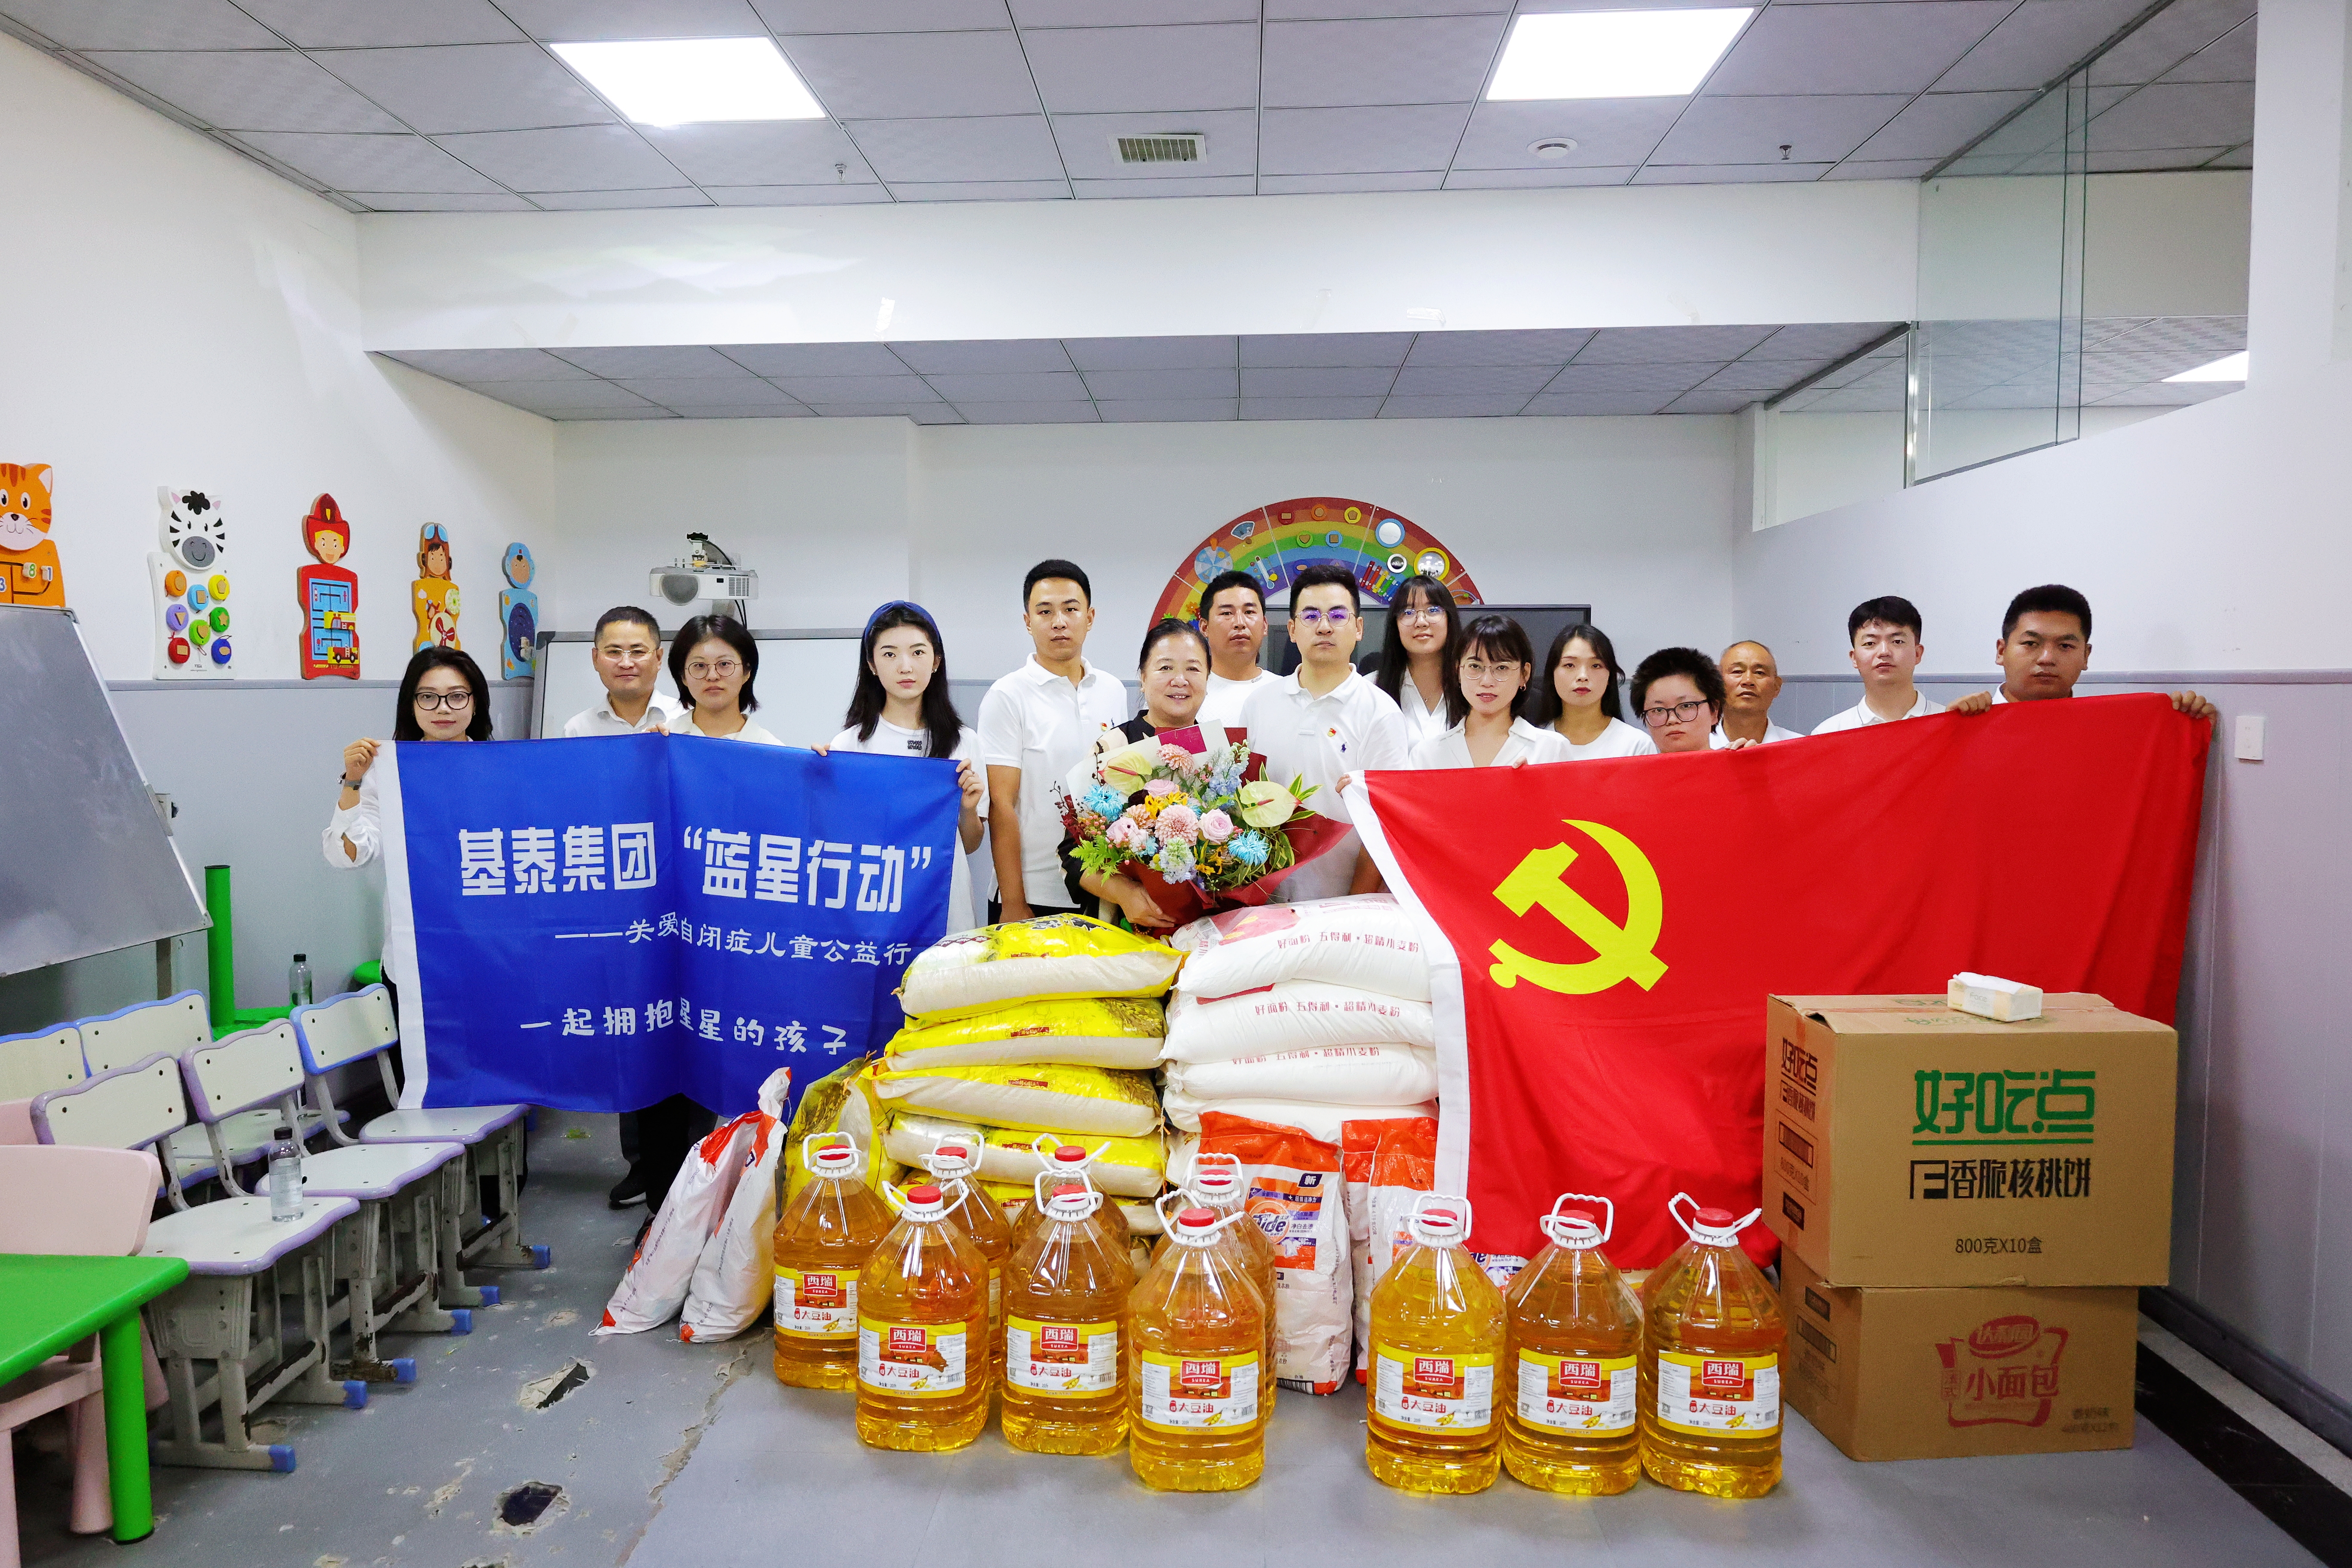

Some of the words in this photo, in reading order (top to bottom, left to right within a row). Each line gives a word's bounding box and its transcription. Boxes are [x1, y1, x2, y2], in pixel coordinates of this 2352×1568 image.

[459, 822, 657, 896] 基泰集团
[684, 827, 932, 913] “蓝星行动”
[1277, 935, 1310, 949] 好面粉
[1255, 1001, 1288, 1015] 好面粉
[521, 997, 848, 1055] 一起拥抱星星的孩子
[1782, 1037, 1818, 1090] 好吃点
[1912, 1069, 2096, 1135] 好吃点
[1304, 1175, 1317, 1185] 新
[1253, 1213, 1286, 1233] Tide
[1955, 1237, 2043, 1255] 800克X10盒
[807, 1275, 833, 1287] 西瑞
[802, 1311, 831, 1321] 大豆油
[894, 1329, 922, 1343] 西瑞
[1045, 1328, 1074, 1342] 西瑞
[887, 1366, 919, 1378] 大豆油
[1038, 1366, 1072, 1377] 大豆油
[1185, 1363, 1216, 1375] 西瑞
[1419, 1360, 1449, 1374] 西瑞
[1564, 1363, 1596, 1377] 西瑞
[1707, 1363, 1739, 1376] 西瑞
[1966, 1365, 2060, 1402] 小面包
[1179, 1403, 1213, 1413] 大豆油
[1411, 1400, 1446, 1413] 大豆油
[1556, 1403, 1593, 1415] 大豆油
[1699, 1403, 1736, 1415] 大豆油
